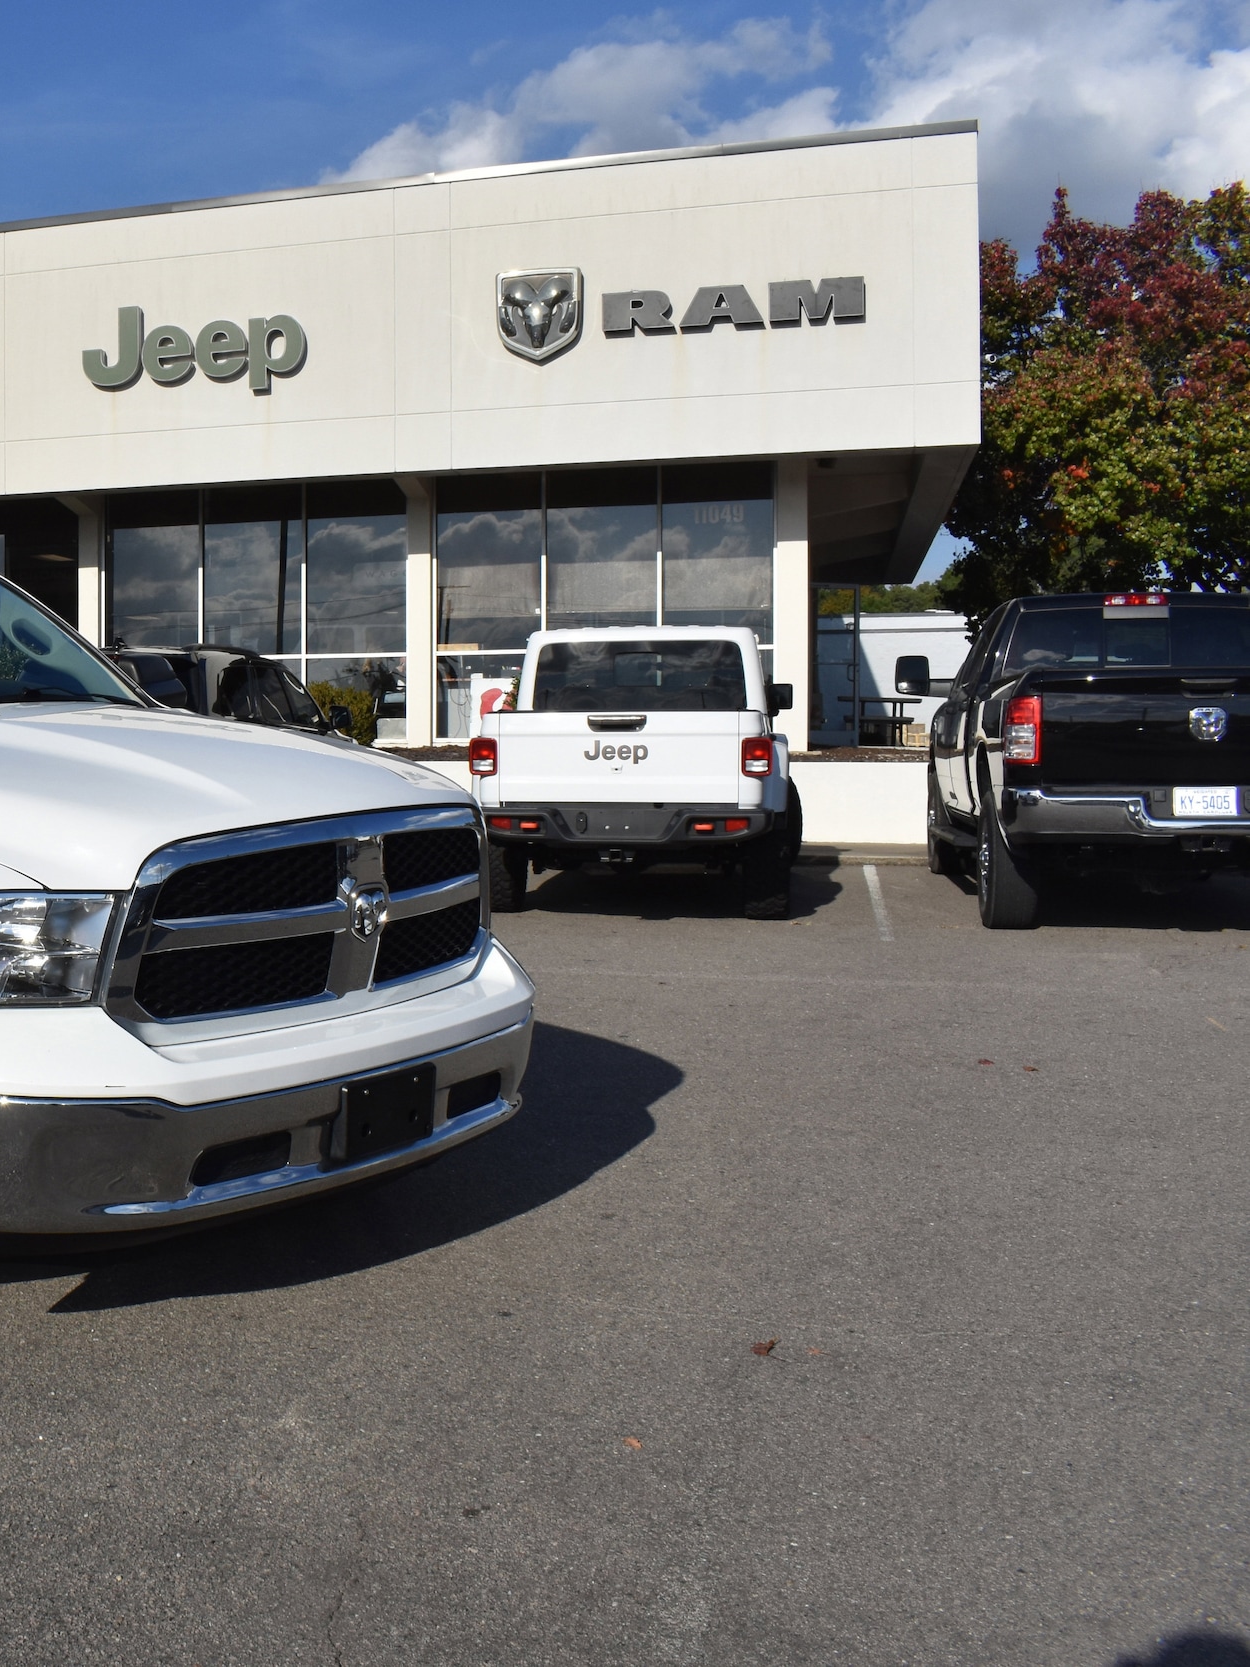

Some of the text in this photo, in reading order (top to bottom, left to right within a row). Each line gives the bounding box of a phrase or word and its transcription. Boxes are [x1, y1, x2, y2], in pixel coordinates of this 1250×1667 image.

[601, 275, 867, 339] RAM
[81, 305, 309, 396] Jeep
[693, 502, 745, 525] 11049
[583, 739, 649, 765] Jeep
[1180, 795, 1230, 810] KY-5405
